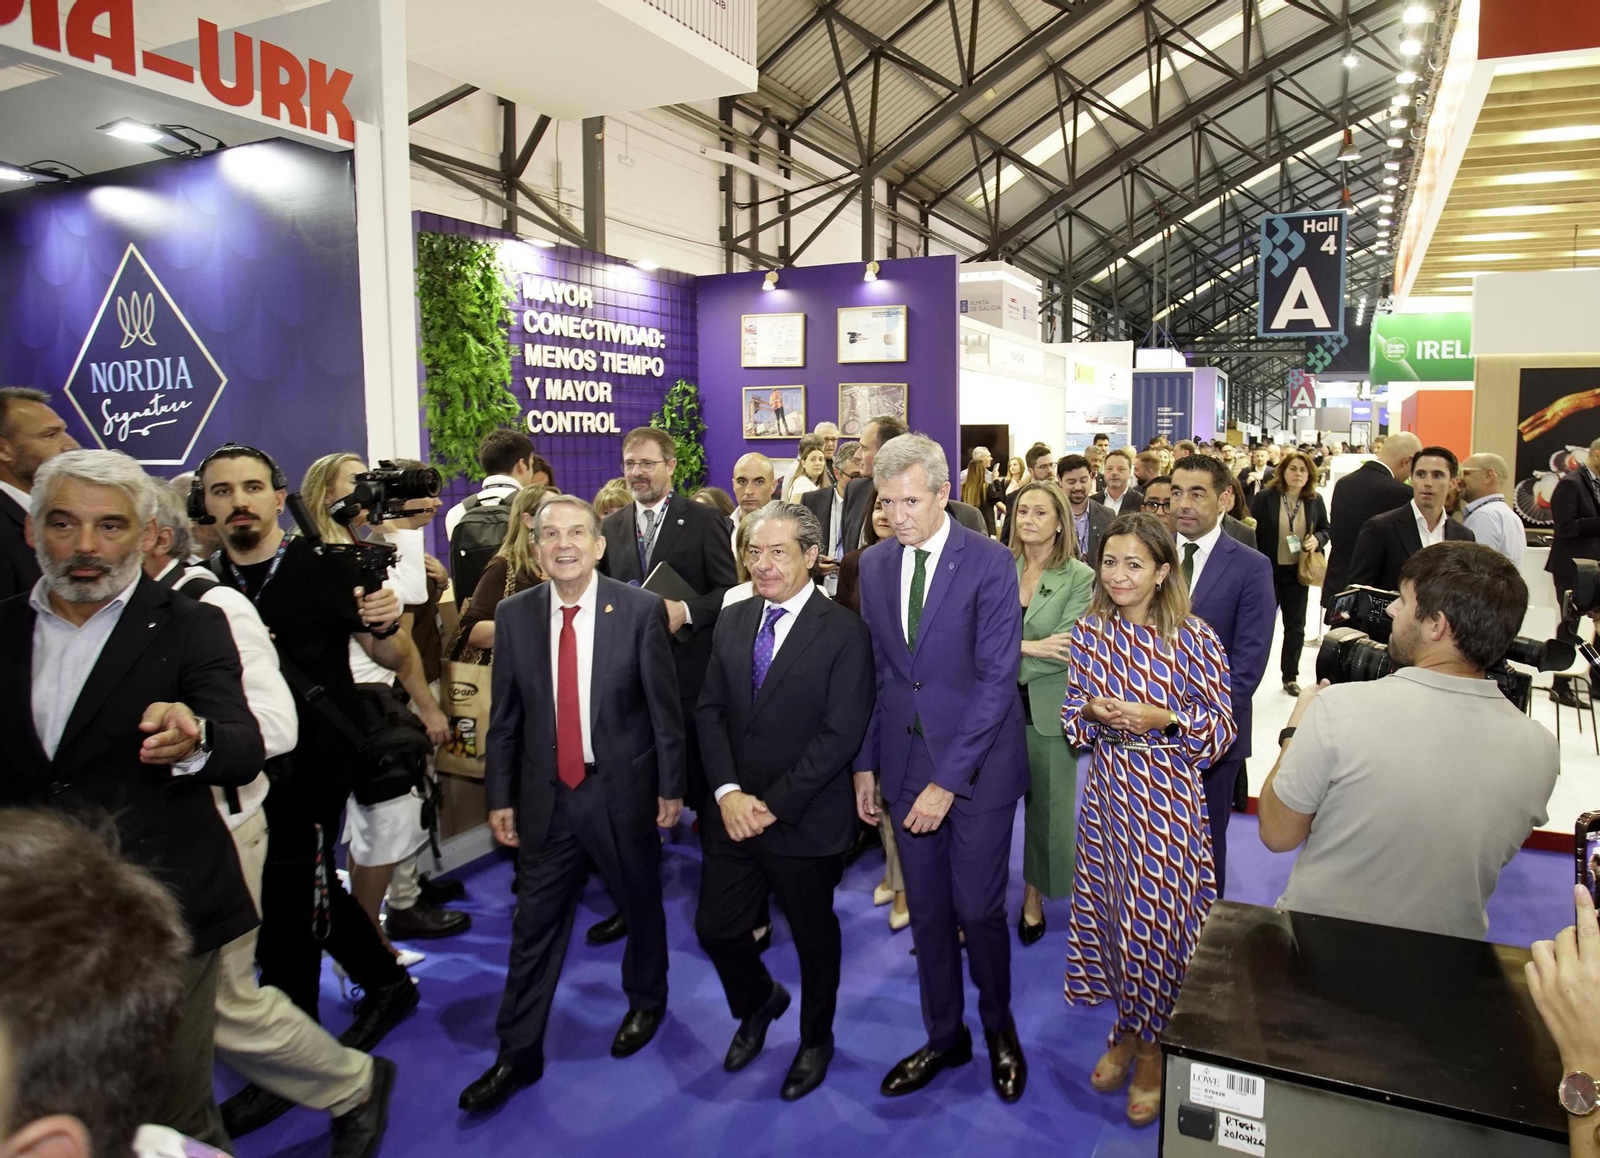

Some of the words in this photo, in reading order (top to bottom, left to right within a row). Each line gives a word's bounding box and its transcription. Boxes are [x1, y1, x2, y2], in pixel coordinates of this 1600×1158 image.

[1303, 216, 1339, 233] Hall
[1320, 234, 1337, 255] 4
[522, 275, 593, 309] MAYOR
[1270, 266, 1332, 329] A
[977, 304, 1002, 312] GALICIA
[523, 309, 666, 349] CONECTIVIDAD:
[525, 343, 597, 372] MENOS
[600, 351, 665, 377] TIEMPO
[89, 356, 194, 394] NORDIA
[525, 377, 540, 400] Y
[545, 378, 613, 403] MAYOR
[1292, 386, 1313, 407] A
[101, 393, 193, 442] Signature
[527, 409, 621, 434] CONTROL
[1192, 1073, 1221, 1087] LOWE
